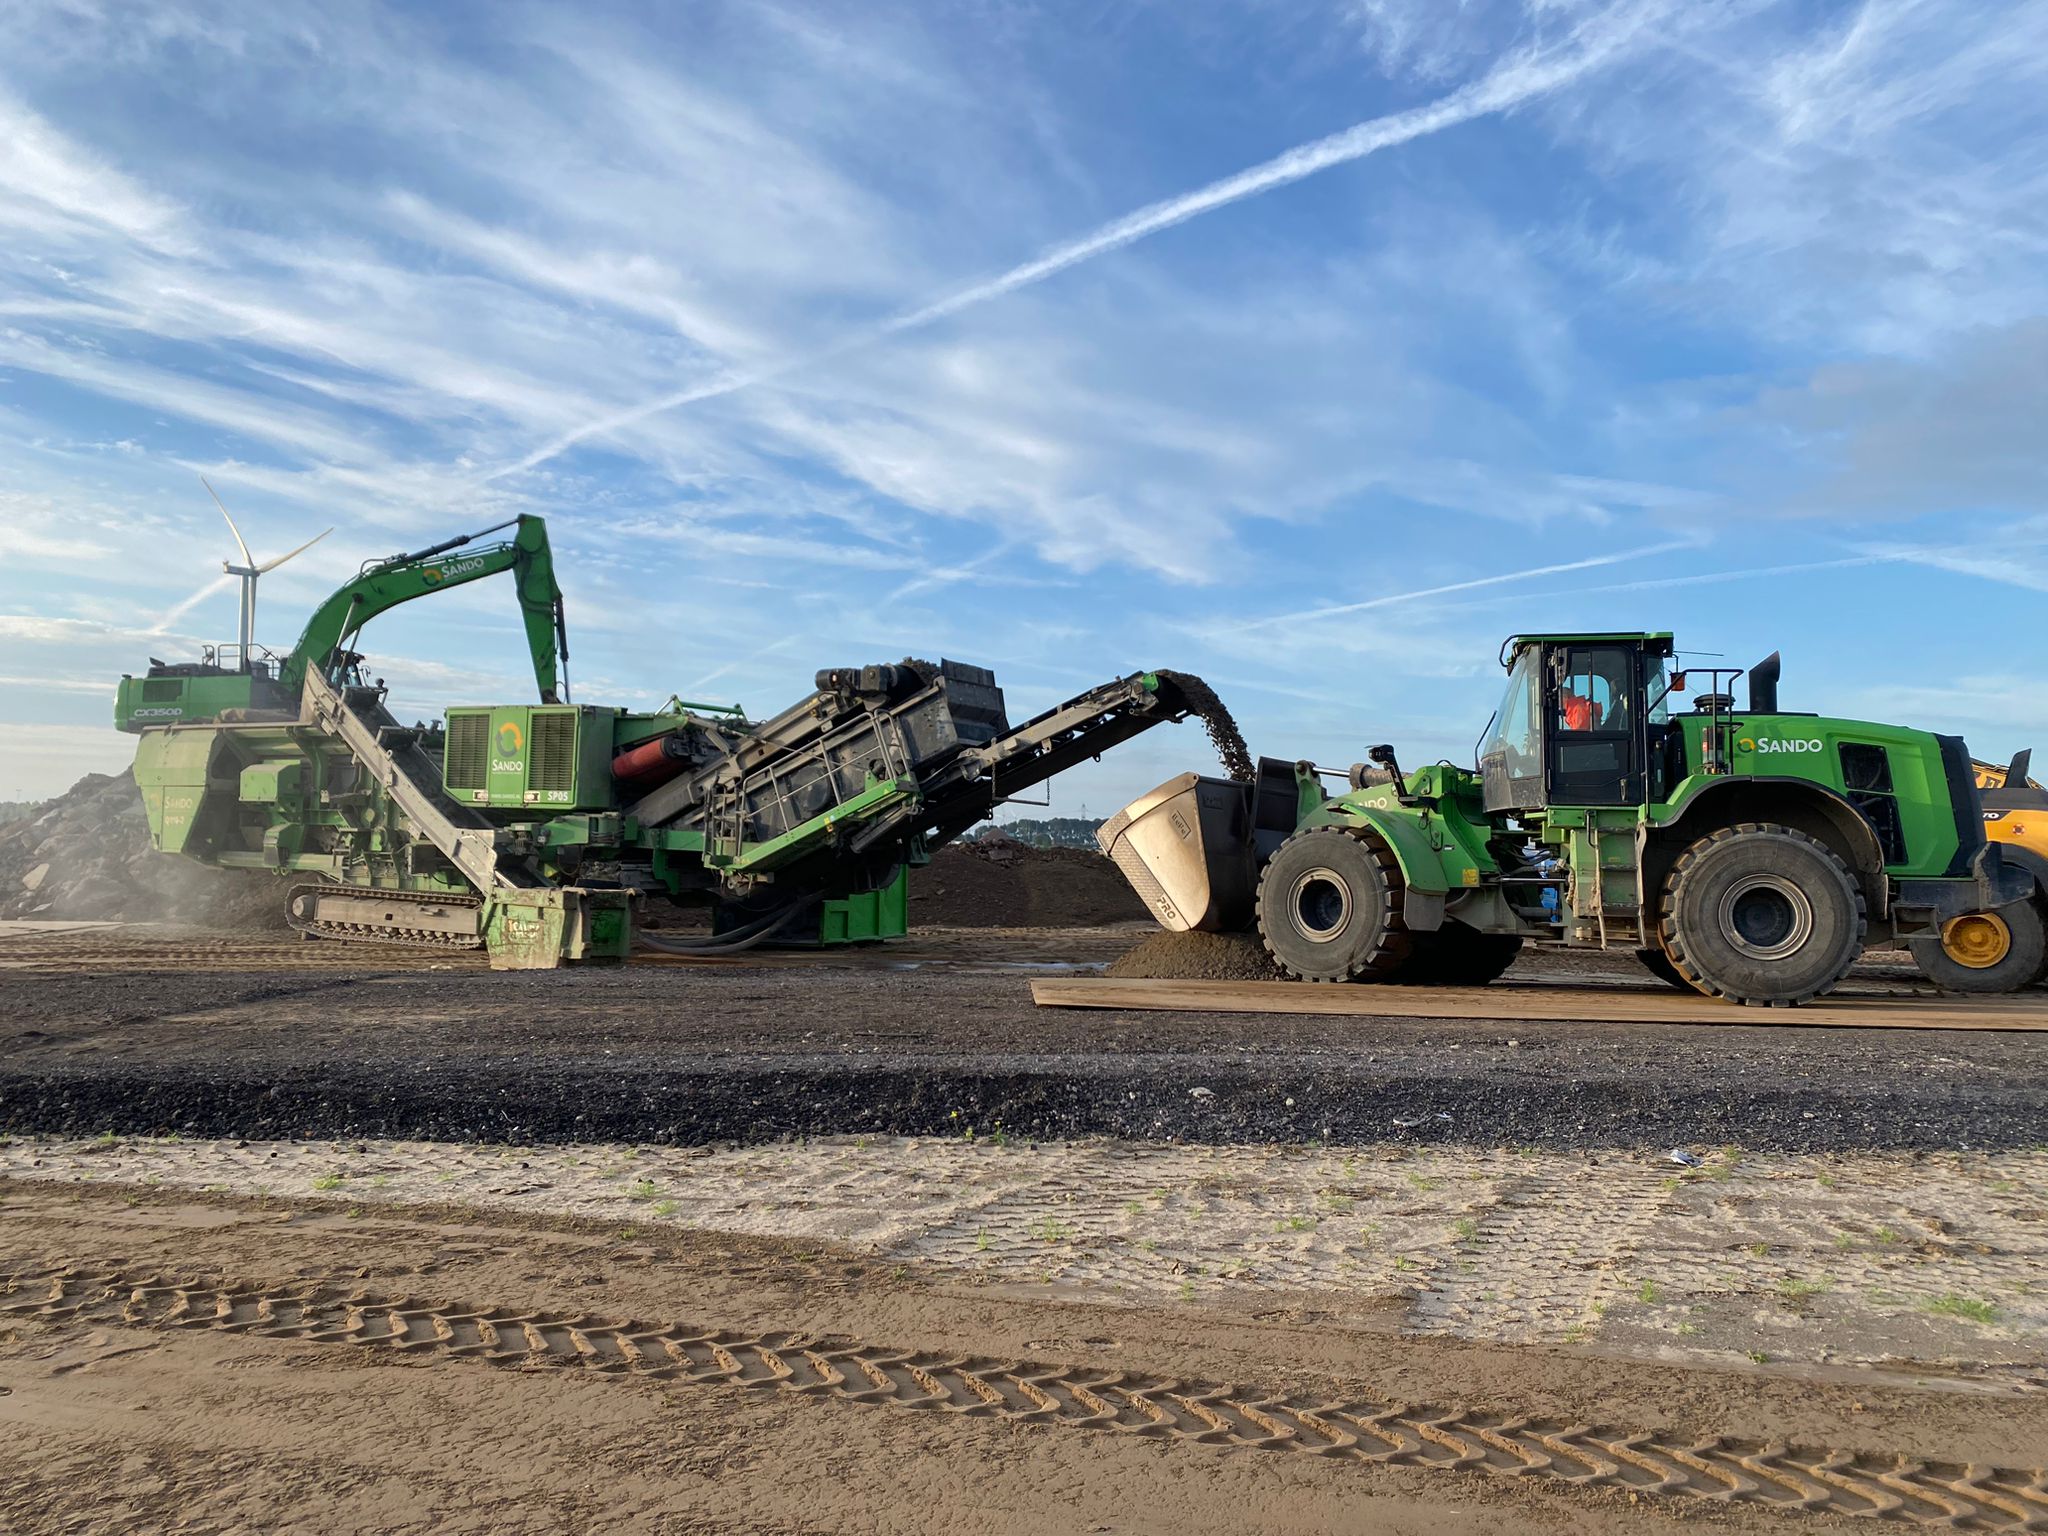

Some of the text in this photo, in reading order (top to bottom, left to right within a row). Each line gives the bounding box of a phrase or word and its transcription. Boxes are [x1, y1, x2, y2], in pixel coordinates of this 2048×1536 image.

[441, 557, 484, 577] SANDO
[1757, 737, 1823, 753] SANDO
[492, 759, 523, 771] SANDO
[165, 795, 193, 809] SANDO
[1157, 896, 1176, 919] PRO
